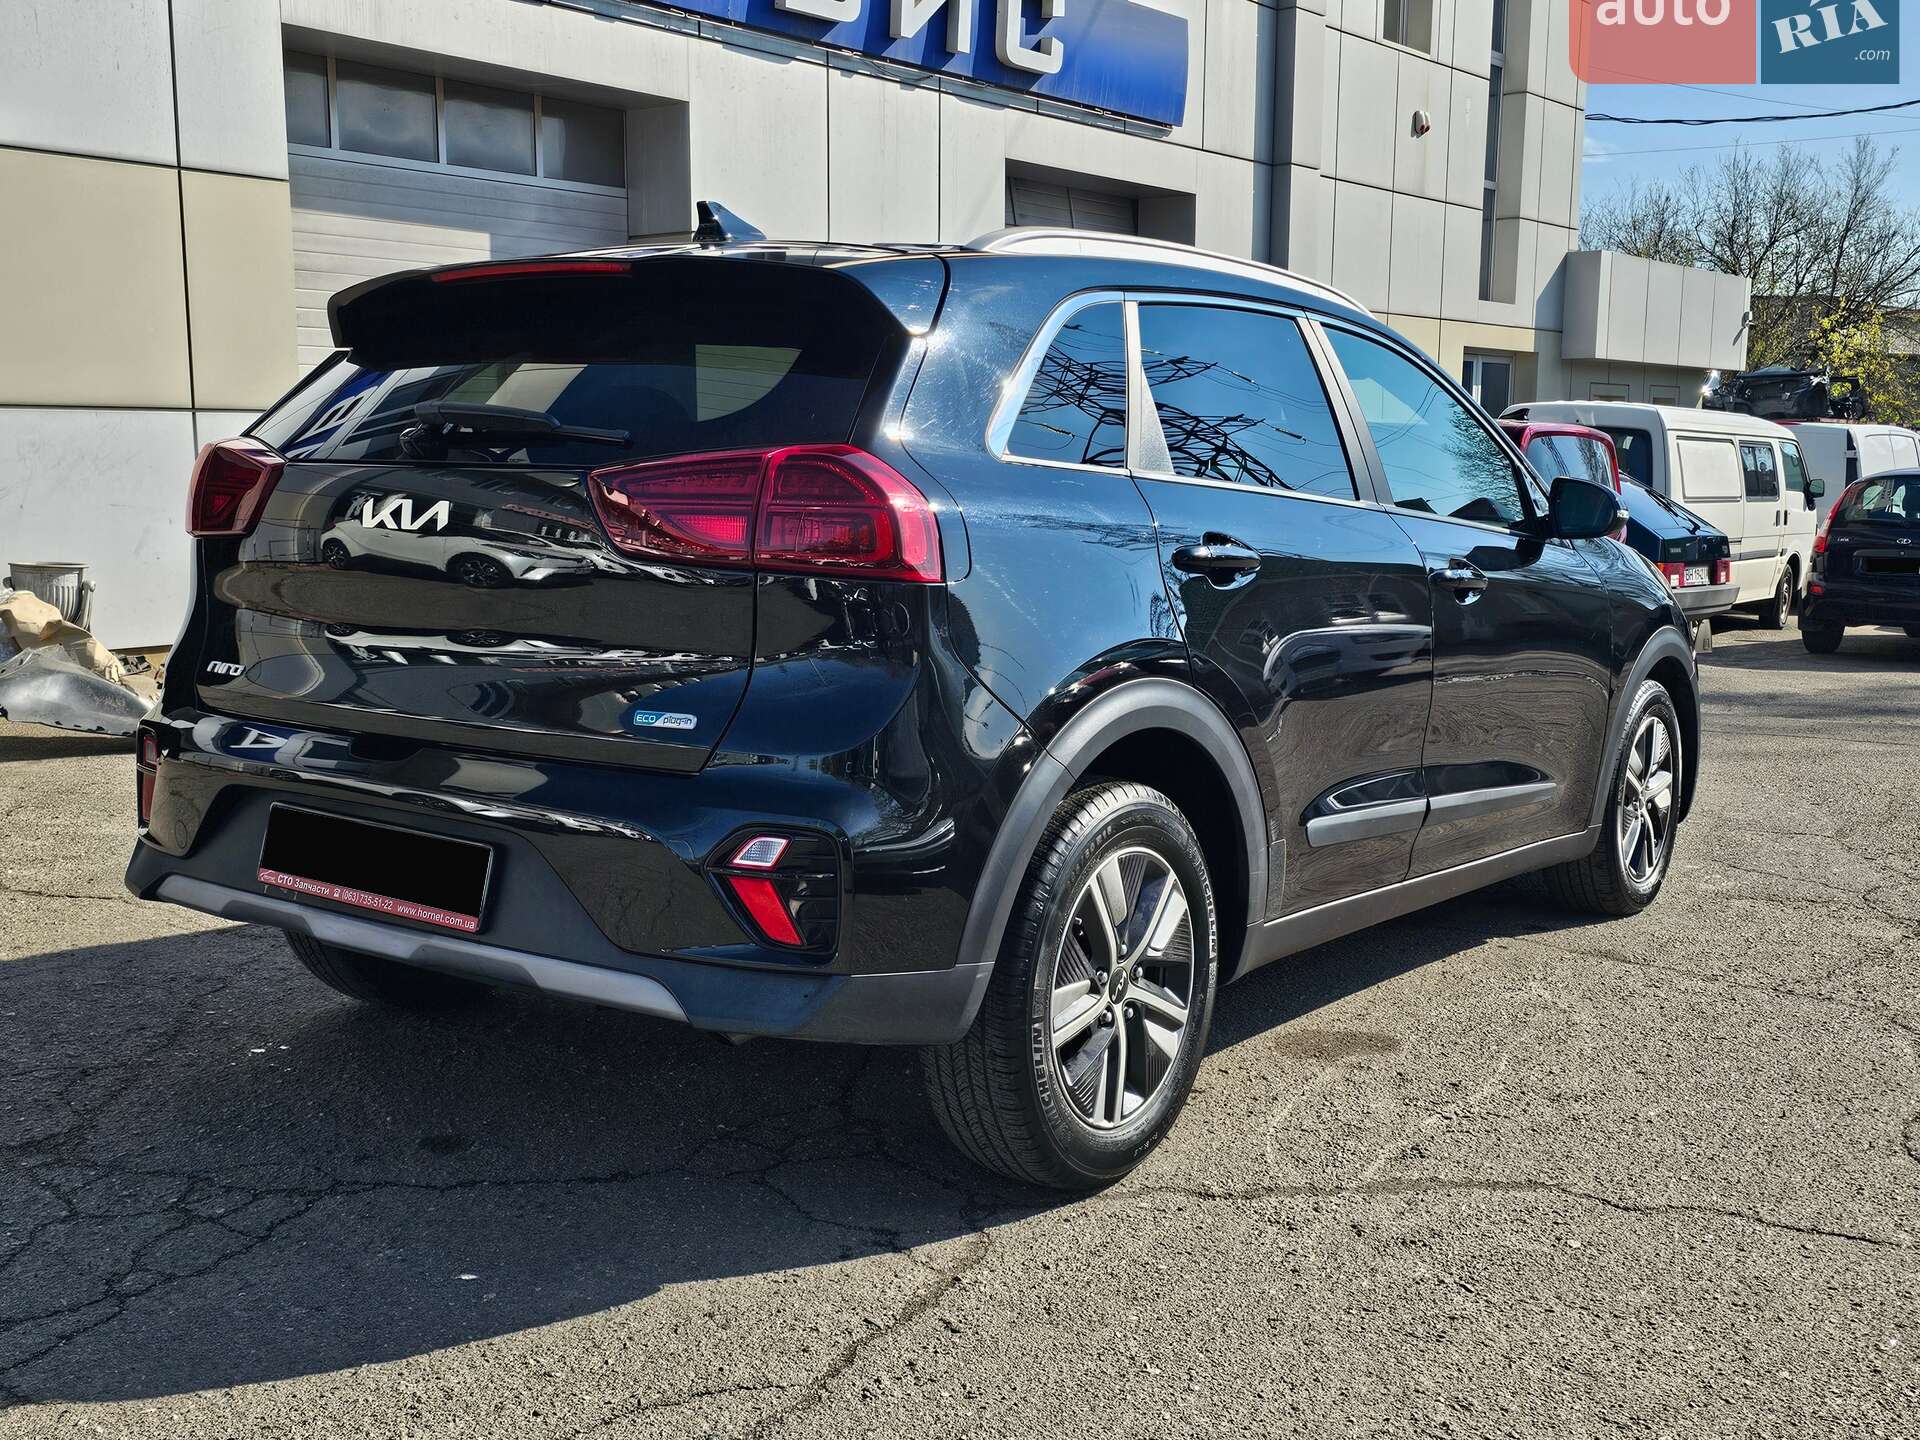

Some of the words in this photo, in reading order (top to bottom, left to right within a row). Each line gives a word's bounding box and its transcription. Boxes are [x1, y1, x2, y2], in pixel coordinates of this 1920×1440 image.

[362, 497, 450, 532] KIA
[636, 714, 656, 723] ECO
[662, 715, 693, 727] plug-in
[277, 874, 293, 886] СТО
[294, 879, 330, 896] Запчасти
[341, 888, 360, 904] (063)
[360, 893, 393, 911] 735-51-22
[397, 903, 475, 929] www.hornet.com.ua
